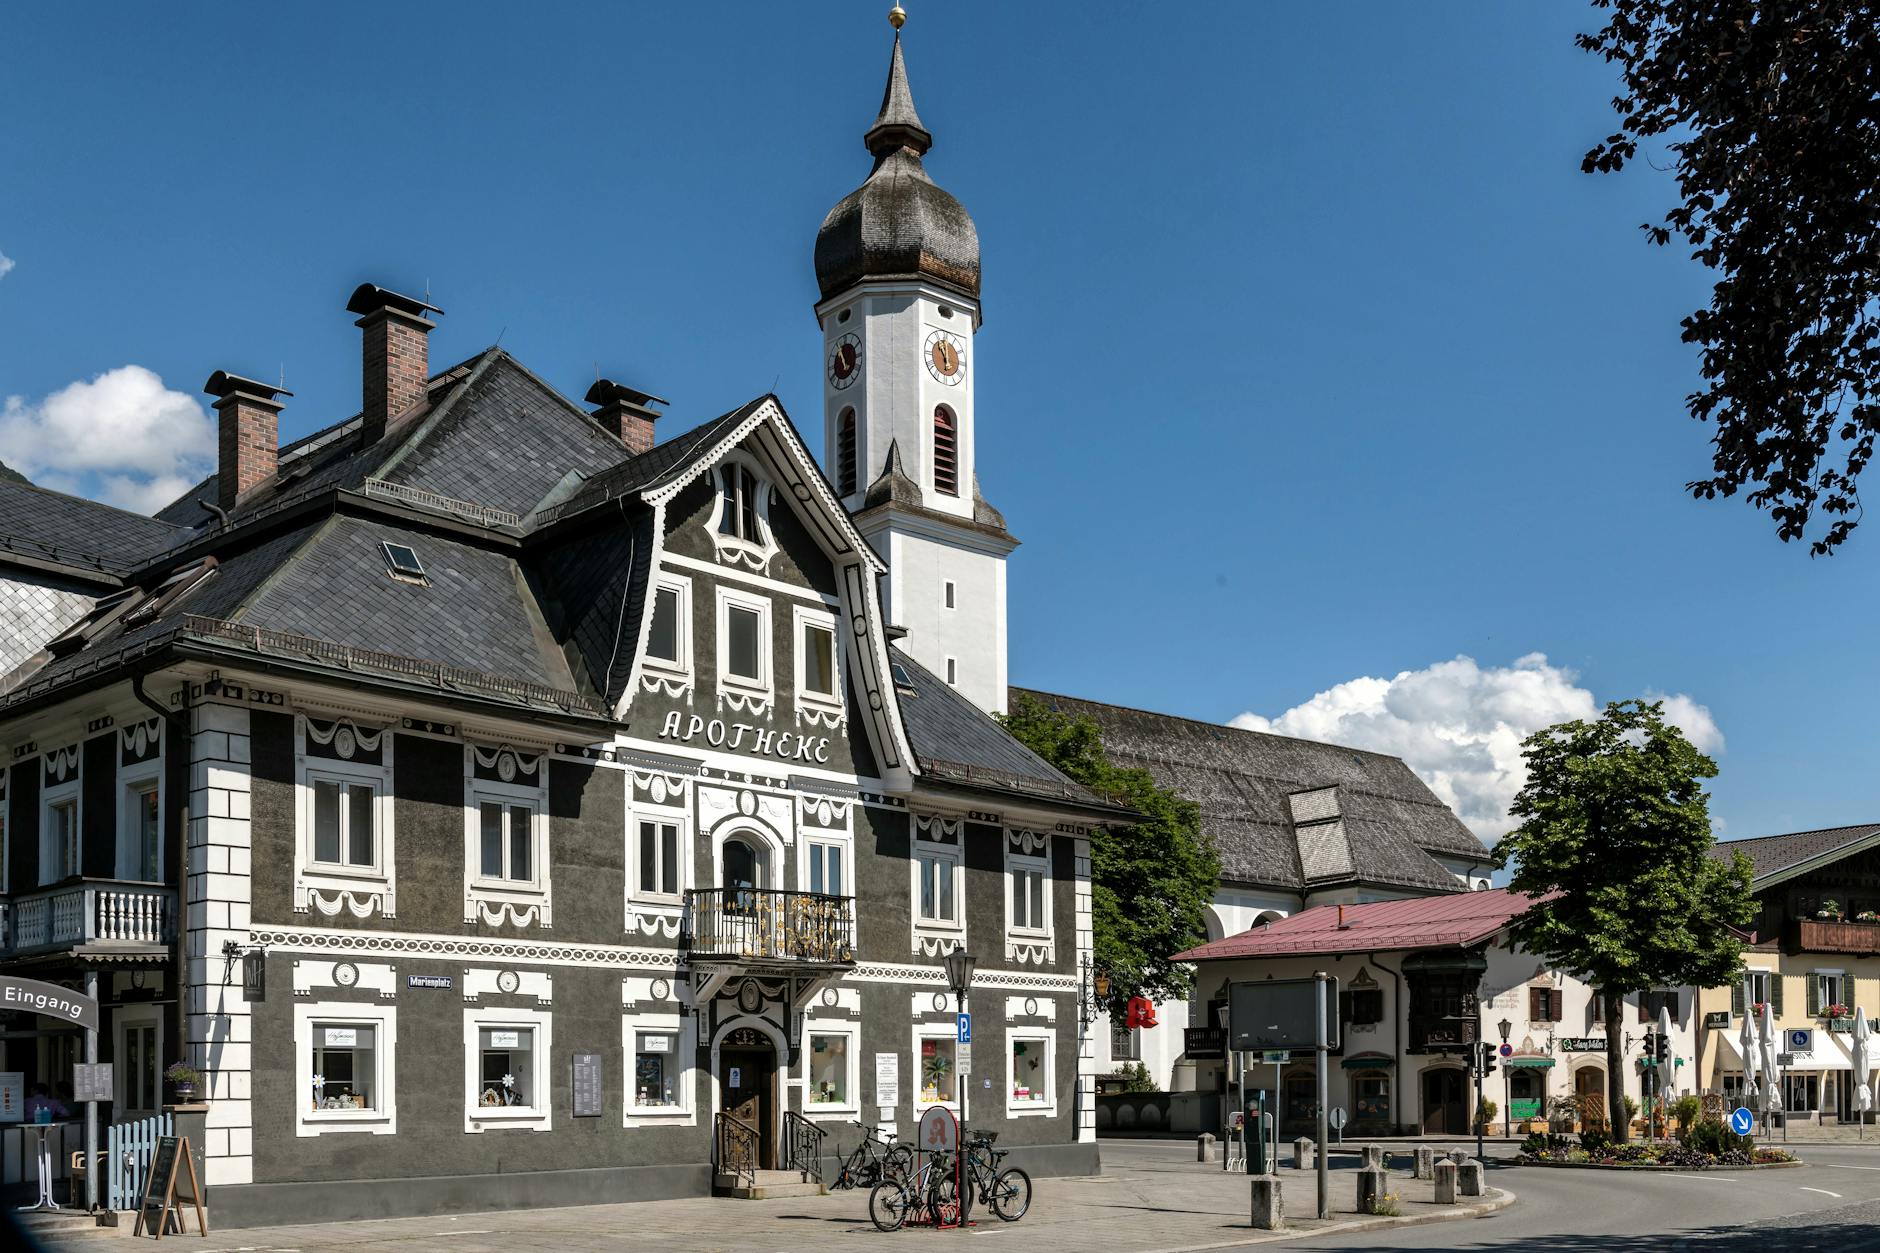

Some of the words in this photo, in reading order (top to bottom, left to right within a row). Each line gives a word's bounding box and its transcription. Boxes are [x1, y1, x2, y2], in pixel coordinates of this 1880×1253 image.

[658, 710, 830, 764] APOTHEKE
[410, 977, 450, 988] Marienplatz
[5, 986, 83, 1018] Eingang
[960, 1017, 968, 1042] P
